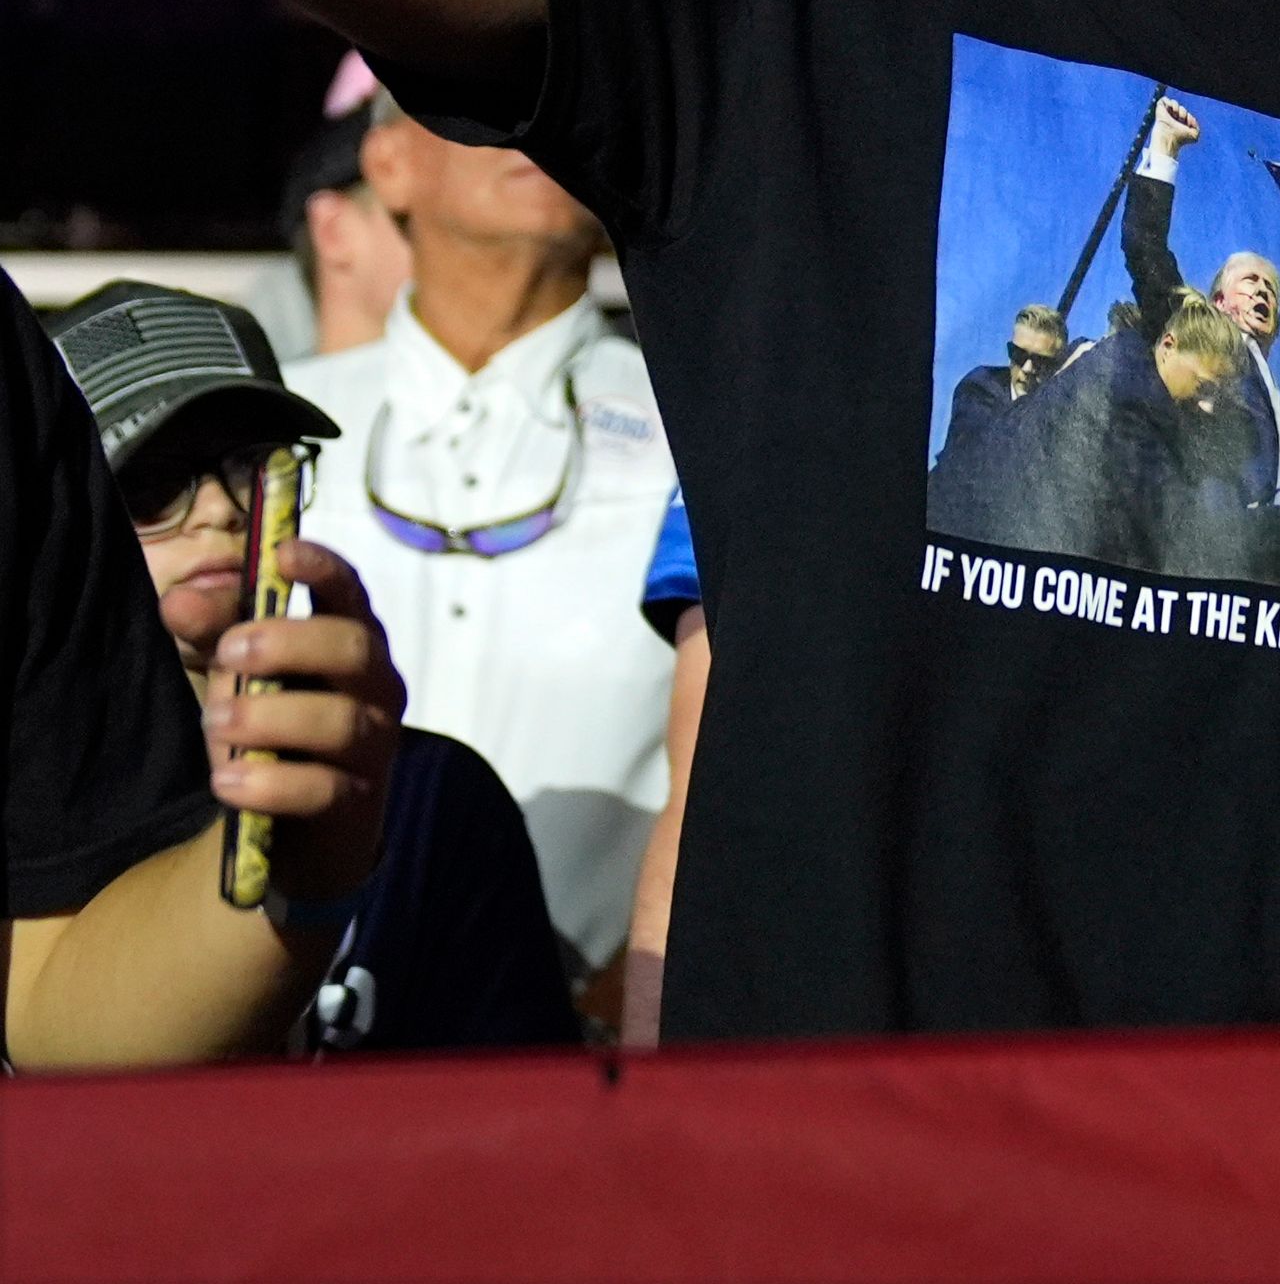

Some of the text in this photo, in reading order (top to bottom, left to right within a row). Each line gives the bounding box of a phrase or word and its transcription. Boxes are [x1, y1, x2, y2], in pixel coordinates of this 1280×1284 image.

[920, 544, 954, 593] IF
[960, 552, 1026, 610] YOU
[1032, 566, 1128, 629] COME
[1130, 585, 1180, 635] AT
[1186, 590, 1250, 644] THE
